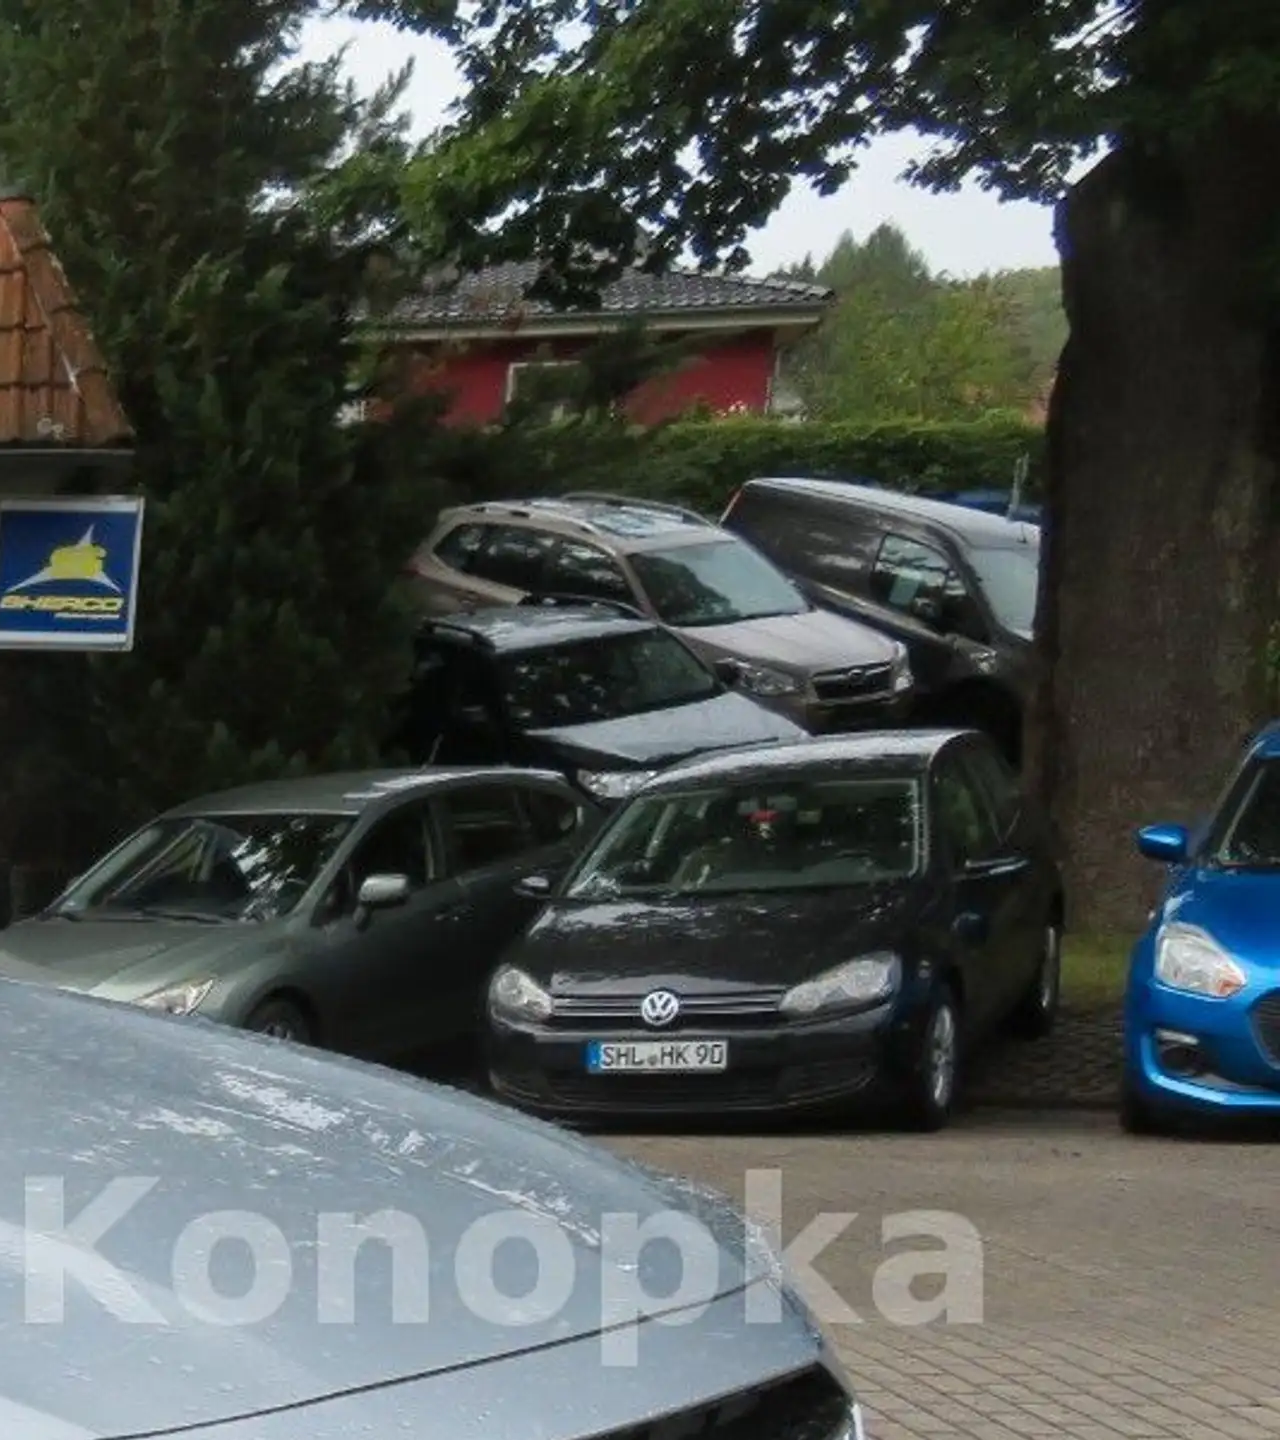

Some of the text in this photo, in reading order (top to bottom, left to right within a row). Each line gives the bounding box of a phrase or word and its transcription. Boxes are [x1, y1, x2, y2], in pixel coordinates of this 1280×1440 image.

[602, 1044, 723, 1066] SHL HK 90
